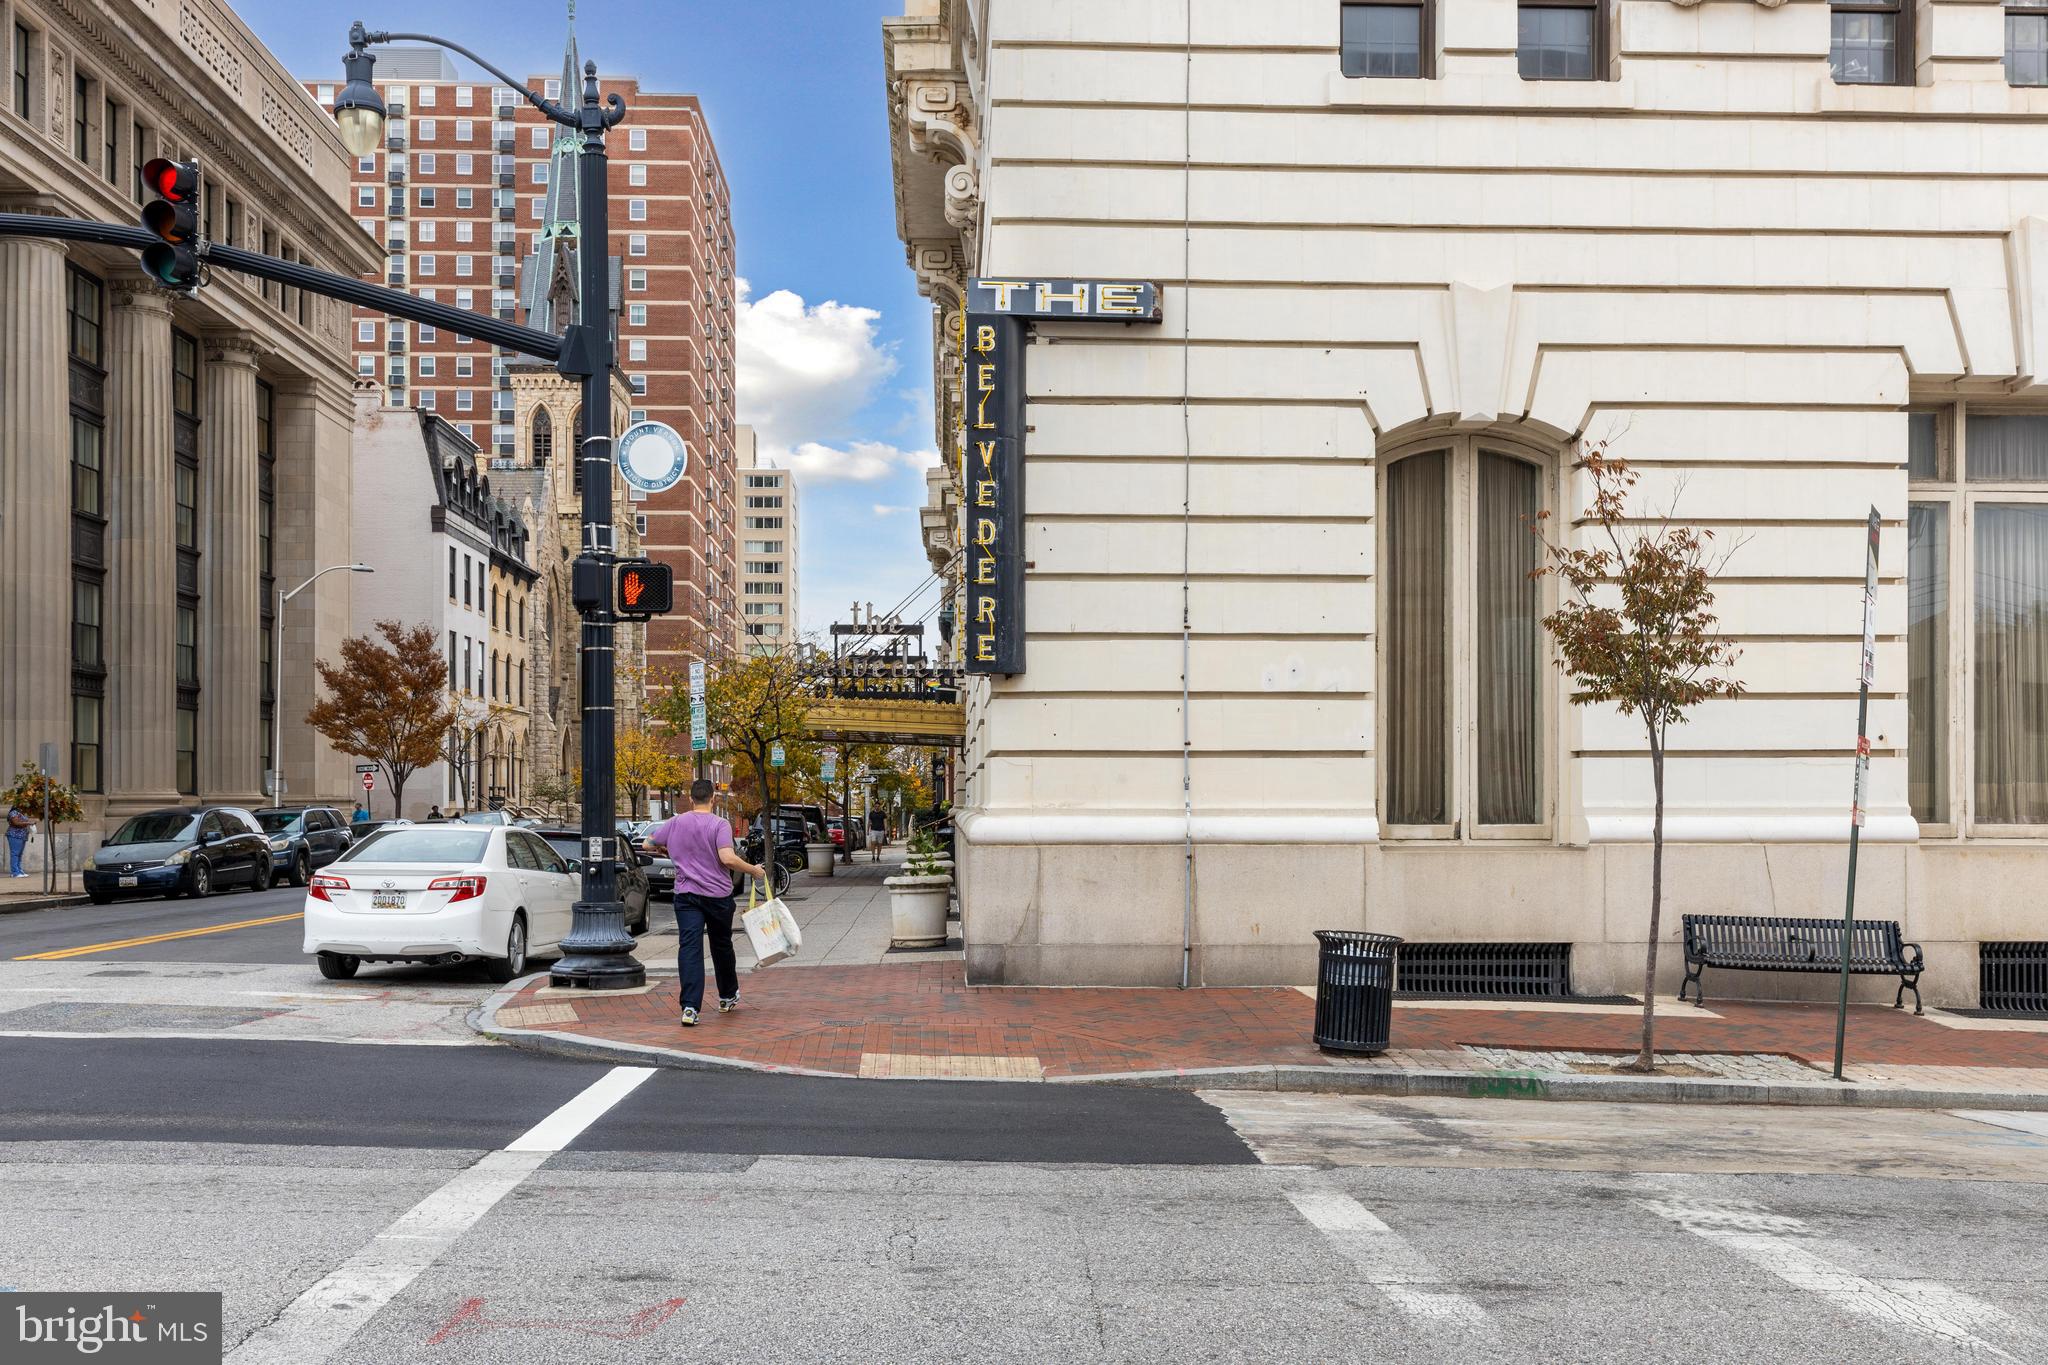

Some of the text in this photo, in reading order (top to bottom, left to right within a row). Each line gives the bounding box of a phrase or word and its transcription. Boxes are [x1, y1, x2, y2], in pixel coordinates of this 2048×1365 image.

[978, 280, 1144, 315] THE
[625, 426, 649, 445] MOUNT
[622, 462, 680, 488] HISTORIC DISTRICT
[977, 325, 997, 662] BELVEDERE
